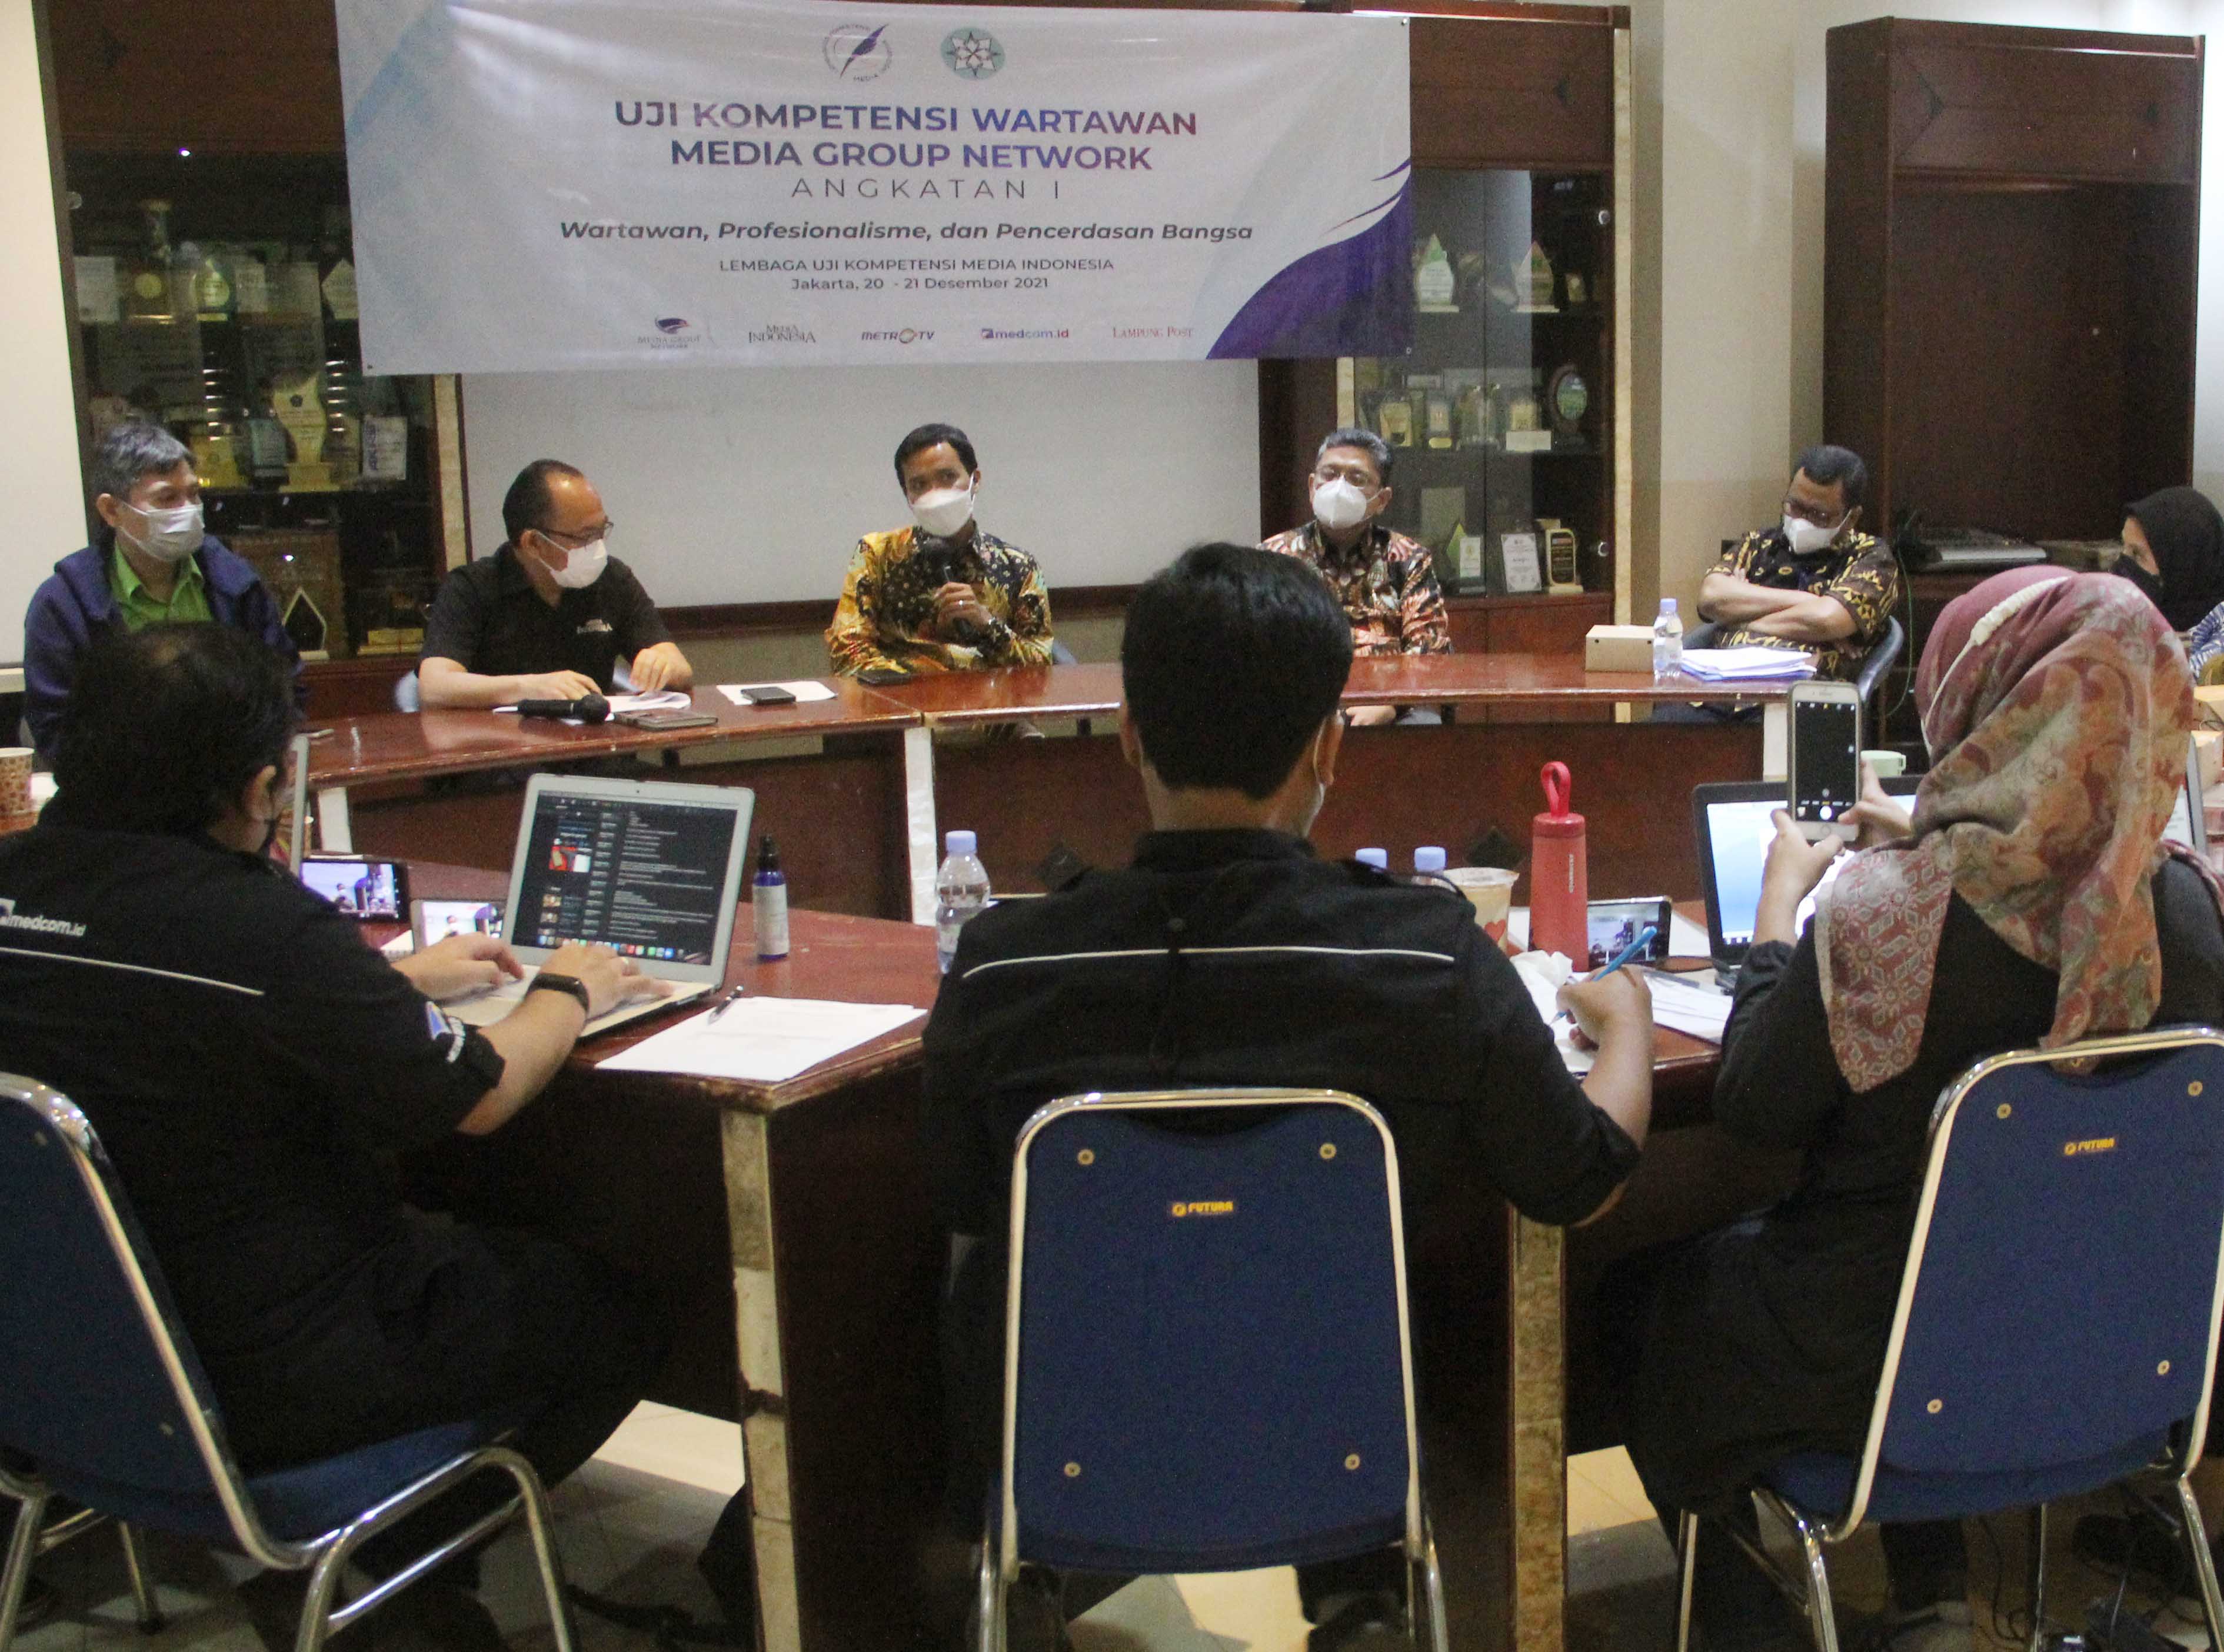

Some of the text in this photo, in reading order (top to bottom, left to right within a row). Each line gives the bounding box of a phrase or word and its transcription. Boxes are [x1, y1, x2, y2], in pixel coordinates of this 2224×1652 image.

[615, 101, 1196, 135] UJI KOMPETENSI WARTAWAN
[672, 141, 1151, 170] MEDIA GROUP NETWORK
[792, 178, 1058, 199] ANGKATAN I
[560, 222, 1252, 242] Wartawan, Profesionalisme, dan Pencerdasan Bangsa
[720, 259, 1114, 271] LEMBAGA UJI KOMPETENSI MEDIA INDONESIA
[792, 278, 858, 291] Jakarta,
[864, 278, 884, 289] 20
[904, 278, 919, 289] 21
[924, 278, 1008, 289] Desember
[1015, 278, 1048, 288] 2021
[918, 330, 935, 340] TV
[995, 328, 1069, 339] medcom.id
[9, 914, 86, 936] medcom.id
